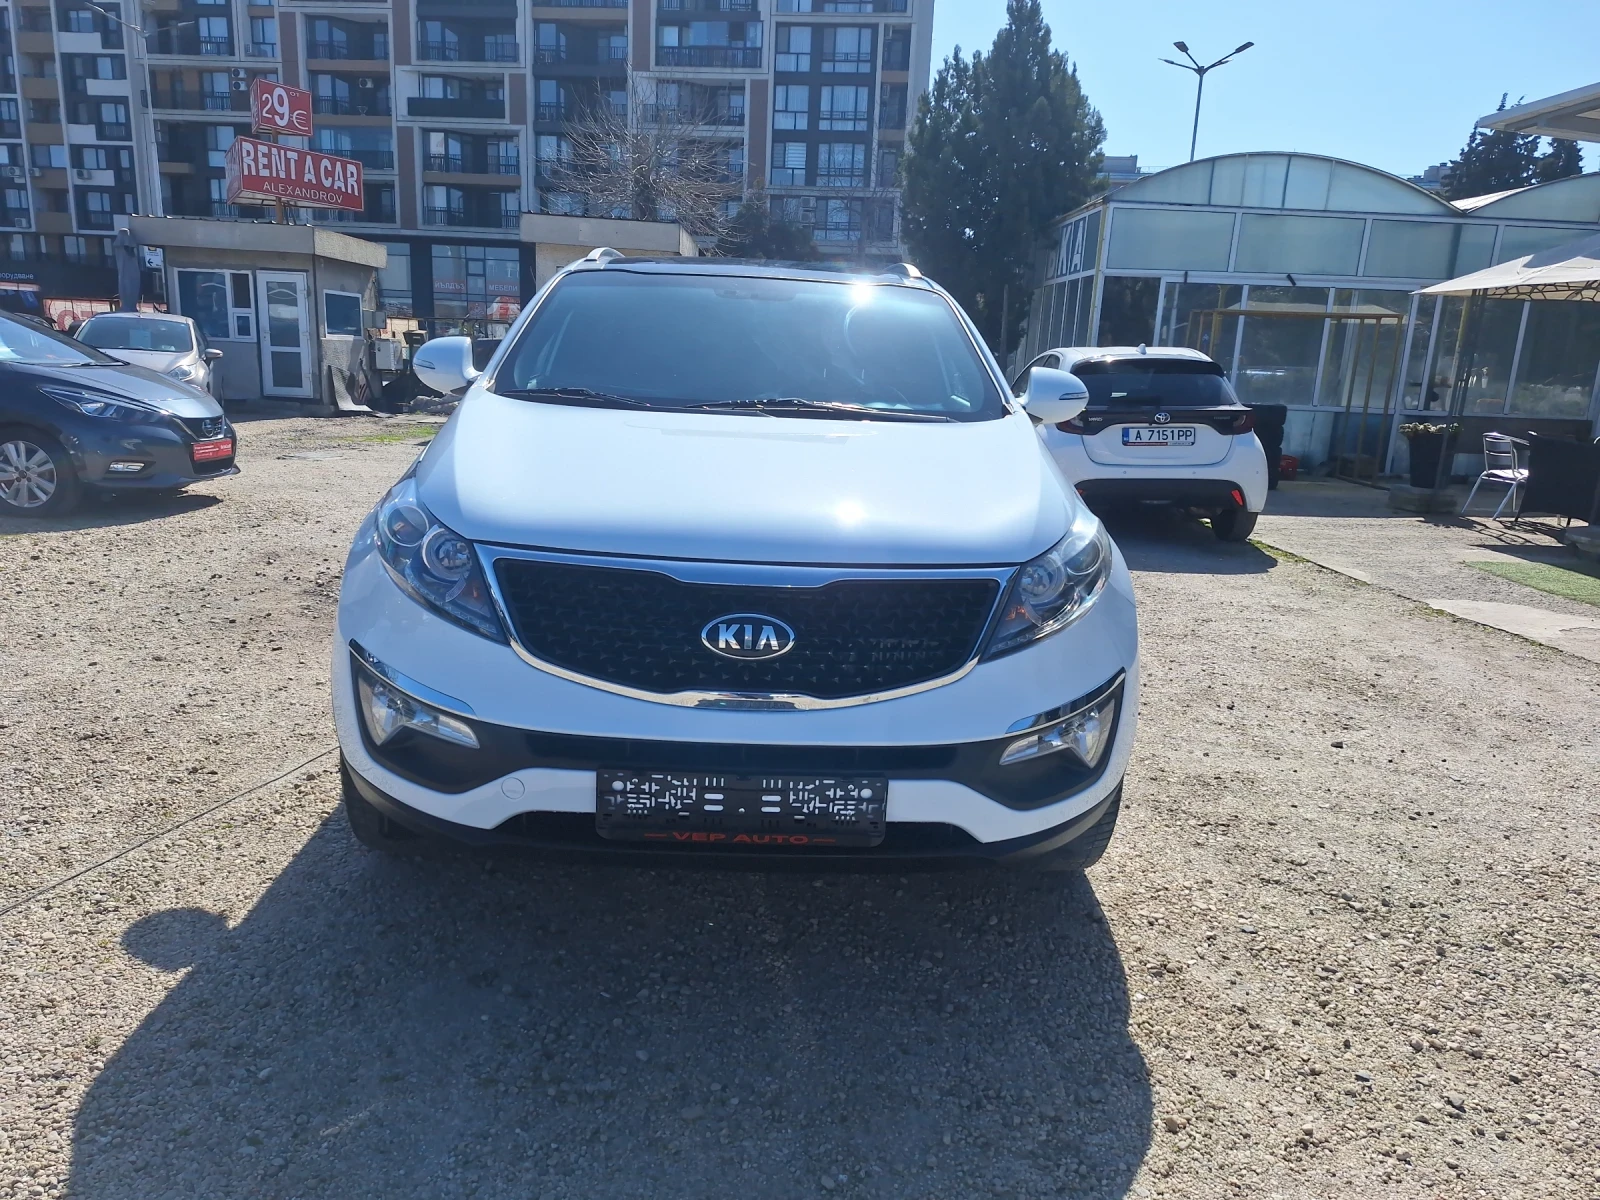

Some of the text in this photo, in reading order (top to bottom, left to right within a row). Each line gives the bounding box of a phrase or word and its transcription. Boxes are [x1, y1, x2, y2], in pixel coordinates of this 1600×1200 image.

[241, 141, 298, 180] RENT
[303, 155, 317, 184] A
[319, 158, 359, 196] CAR
[263, 181, 343, 203] ALEXANDROV
[489, 284, 518, 292] МЕБЕЛИ
[1134, 429, 1142, 441] A
[718, 623, 780, 650] KIA
[672, 832, 810, 845] VEP AUTO
